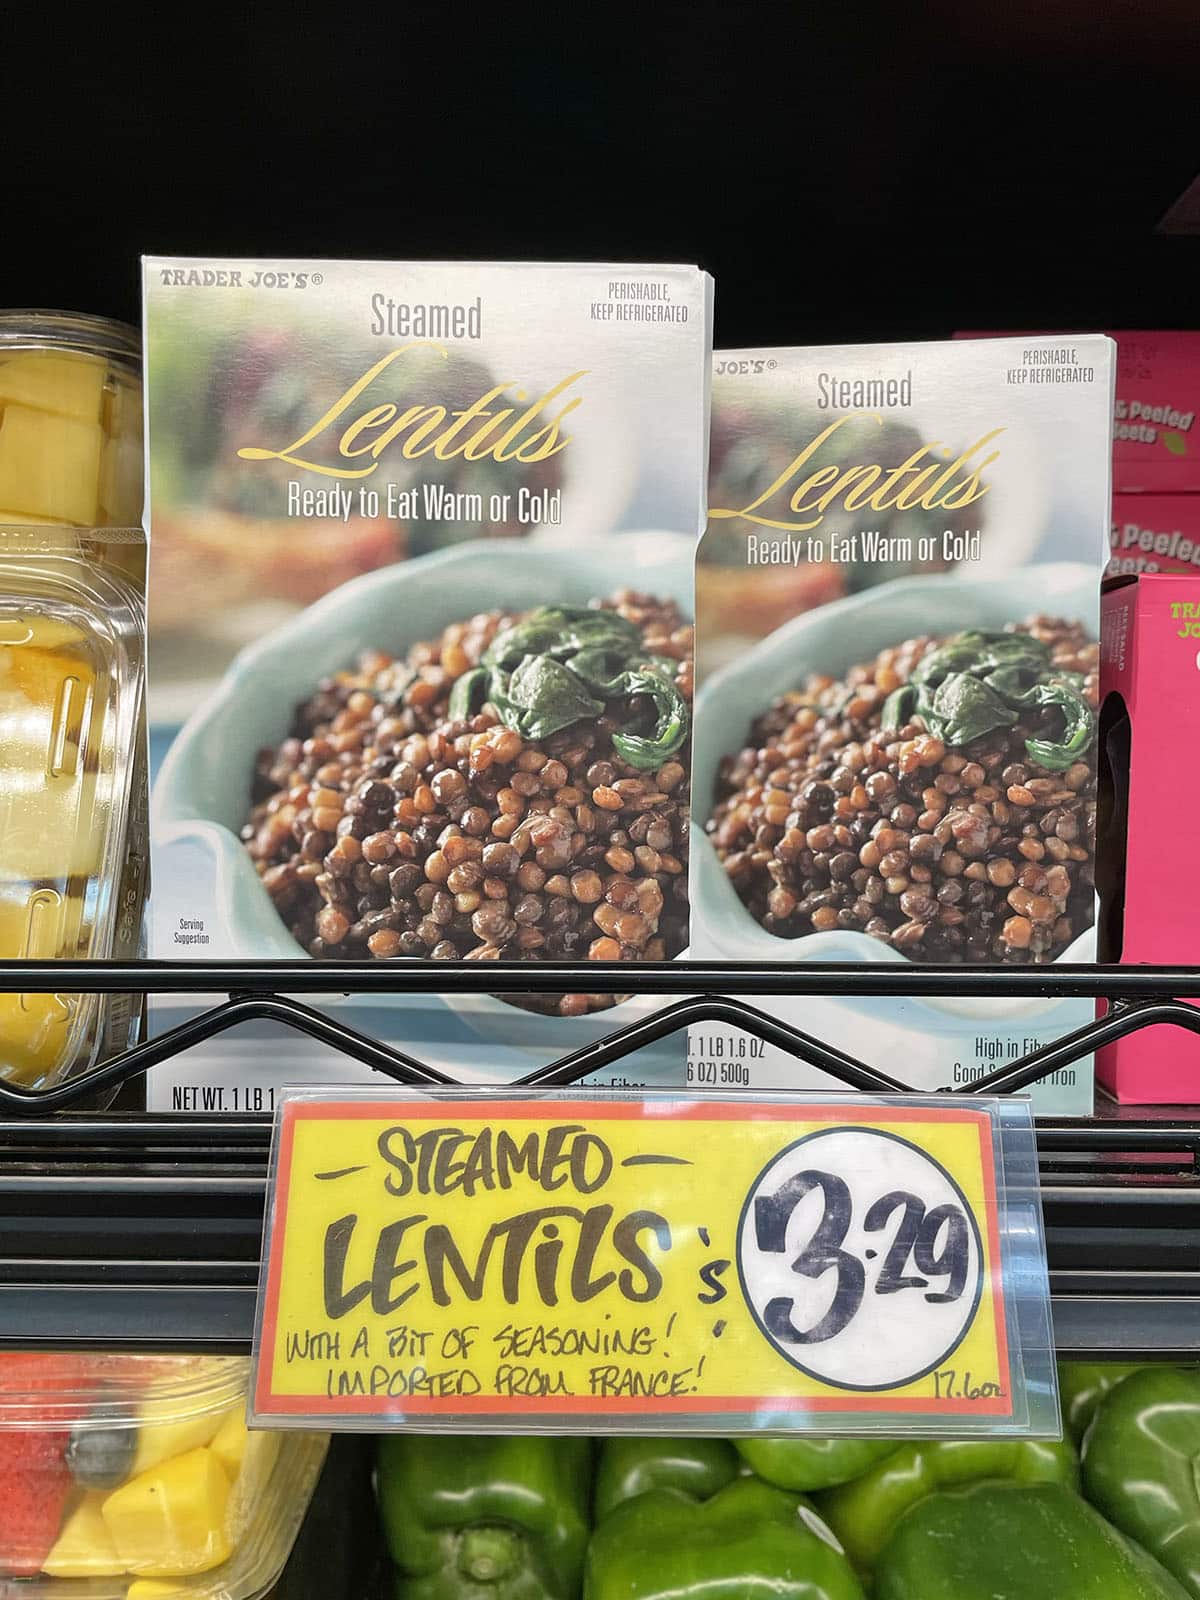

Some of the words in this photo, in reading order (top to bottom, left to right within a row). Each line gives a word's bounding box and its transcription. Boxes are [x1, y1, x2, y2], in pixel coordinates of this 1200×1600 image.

[161, 269, 242, 287] TRADER
[608, 282, 671, 302] PERISHABLE,
[371, 293, 482, 339] Steamed
[590, 303, 614, 320] KEEP
[616, 304, 688, 322] REFRIGERATED
[1023, 349, 1079, 365] PERISHABLE,
[1007, 369, 1028, 384] KEEP
[1030, 368, 1094, 383] REFRIGERATED
[817, 370, 912, 409] Steamed
[237, 340, 593, 479] Lentils
[1130, 400, 1195, 431] Peeled
[708, 412, 1007, 530] Lentils
[288, 481, 352, 521] Ready
[359, 486, 378, 518] to
[387, 484, 418, 519] Eat
[423, 484, 482, 521] Warm
[490, 494, 511, 522] or
[518, 487, 561, 524] Cold
[747, 535, 801, 567] Ready
[807, 536, 823, 563] to
[830, 533, 857, 562] Eat
[861, 531, 911, 562] Warm
[918, 538, 936, 561] or
[943, 530, 981, 561] Cold
[1106, 556, 1159, 573] eets
[179, 918, 204, 931] Serving
[174, 932, 210, 944] Suggestion
[699, 1036, 704, 1056] 1
[709, 1037, 723, 1057] LB
[728, 1037, 745, 1058] 1.6
[750, 1038, 765, 1058] OZ
[975, 1037, 1003, 1059] High
[1007, 1038, 1018, 1057] in
[698, 1062, 717, 1084] OZ)
[720, 1062, 750, 1085] 500g
[953, 1062, 984, 1082] Good
[173, 1086, 198, 1110] NET
[202, 1086, 228, 1110] WT.
[232, 1087, 238, 1110] 1
[245, 1087, 262, 1110] LB
[376, 1124, 613, 1197] STEAMED
[754, 1169, 970, 1345] 3.29
[286, 1329, 340, 1363] WITH
[350, 1326, 369, 1358] A
[441, 1325, 480, 1359] OF
[328, 1365, 482, 1399] IMPORTED
[494, 1364, 575, 1398] FROM
[589, 1355, 706, 1398] FRANCE!
